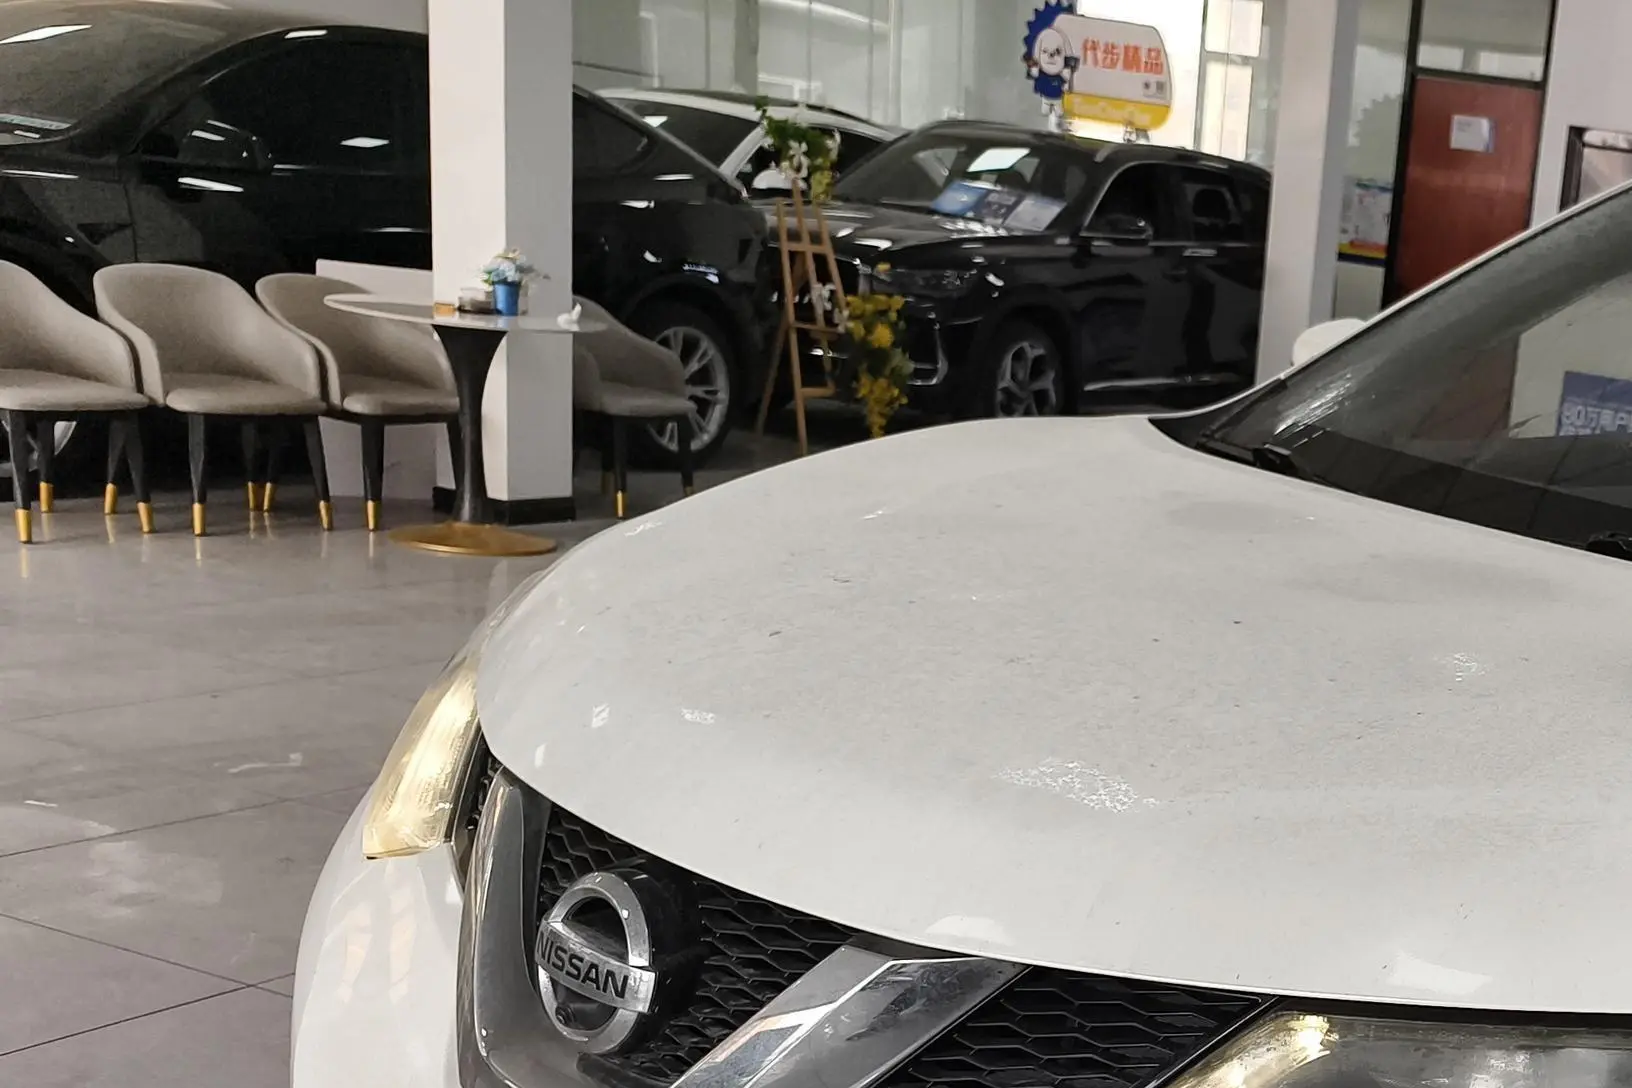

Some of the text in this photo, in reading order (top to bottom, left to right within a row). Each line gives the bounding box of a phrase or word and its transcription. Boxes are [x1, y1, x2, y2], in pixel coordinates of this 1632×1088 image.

[1082, 37, 1163, 75] 代步精品
[537, 931, 630, 1000] NISSAN
